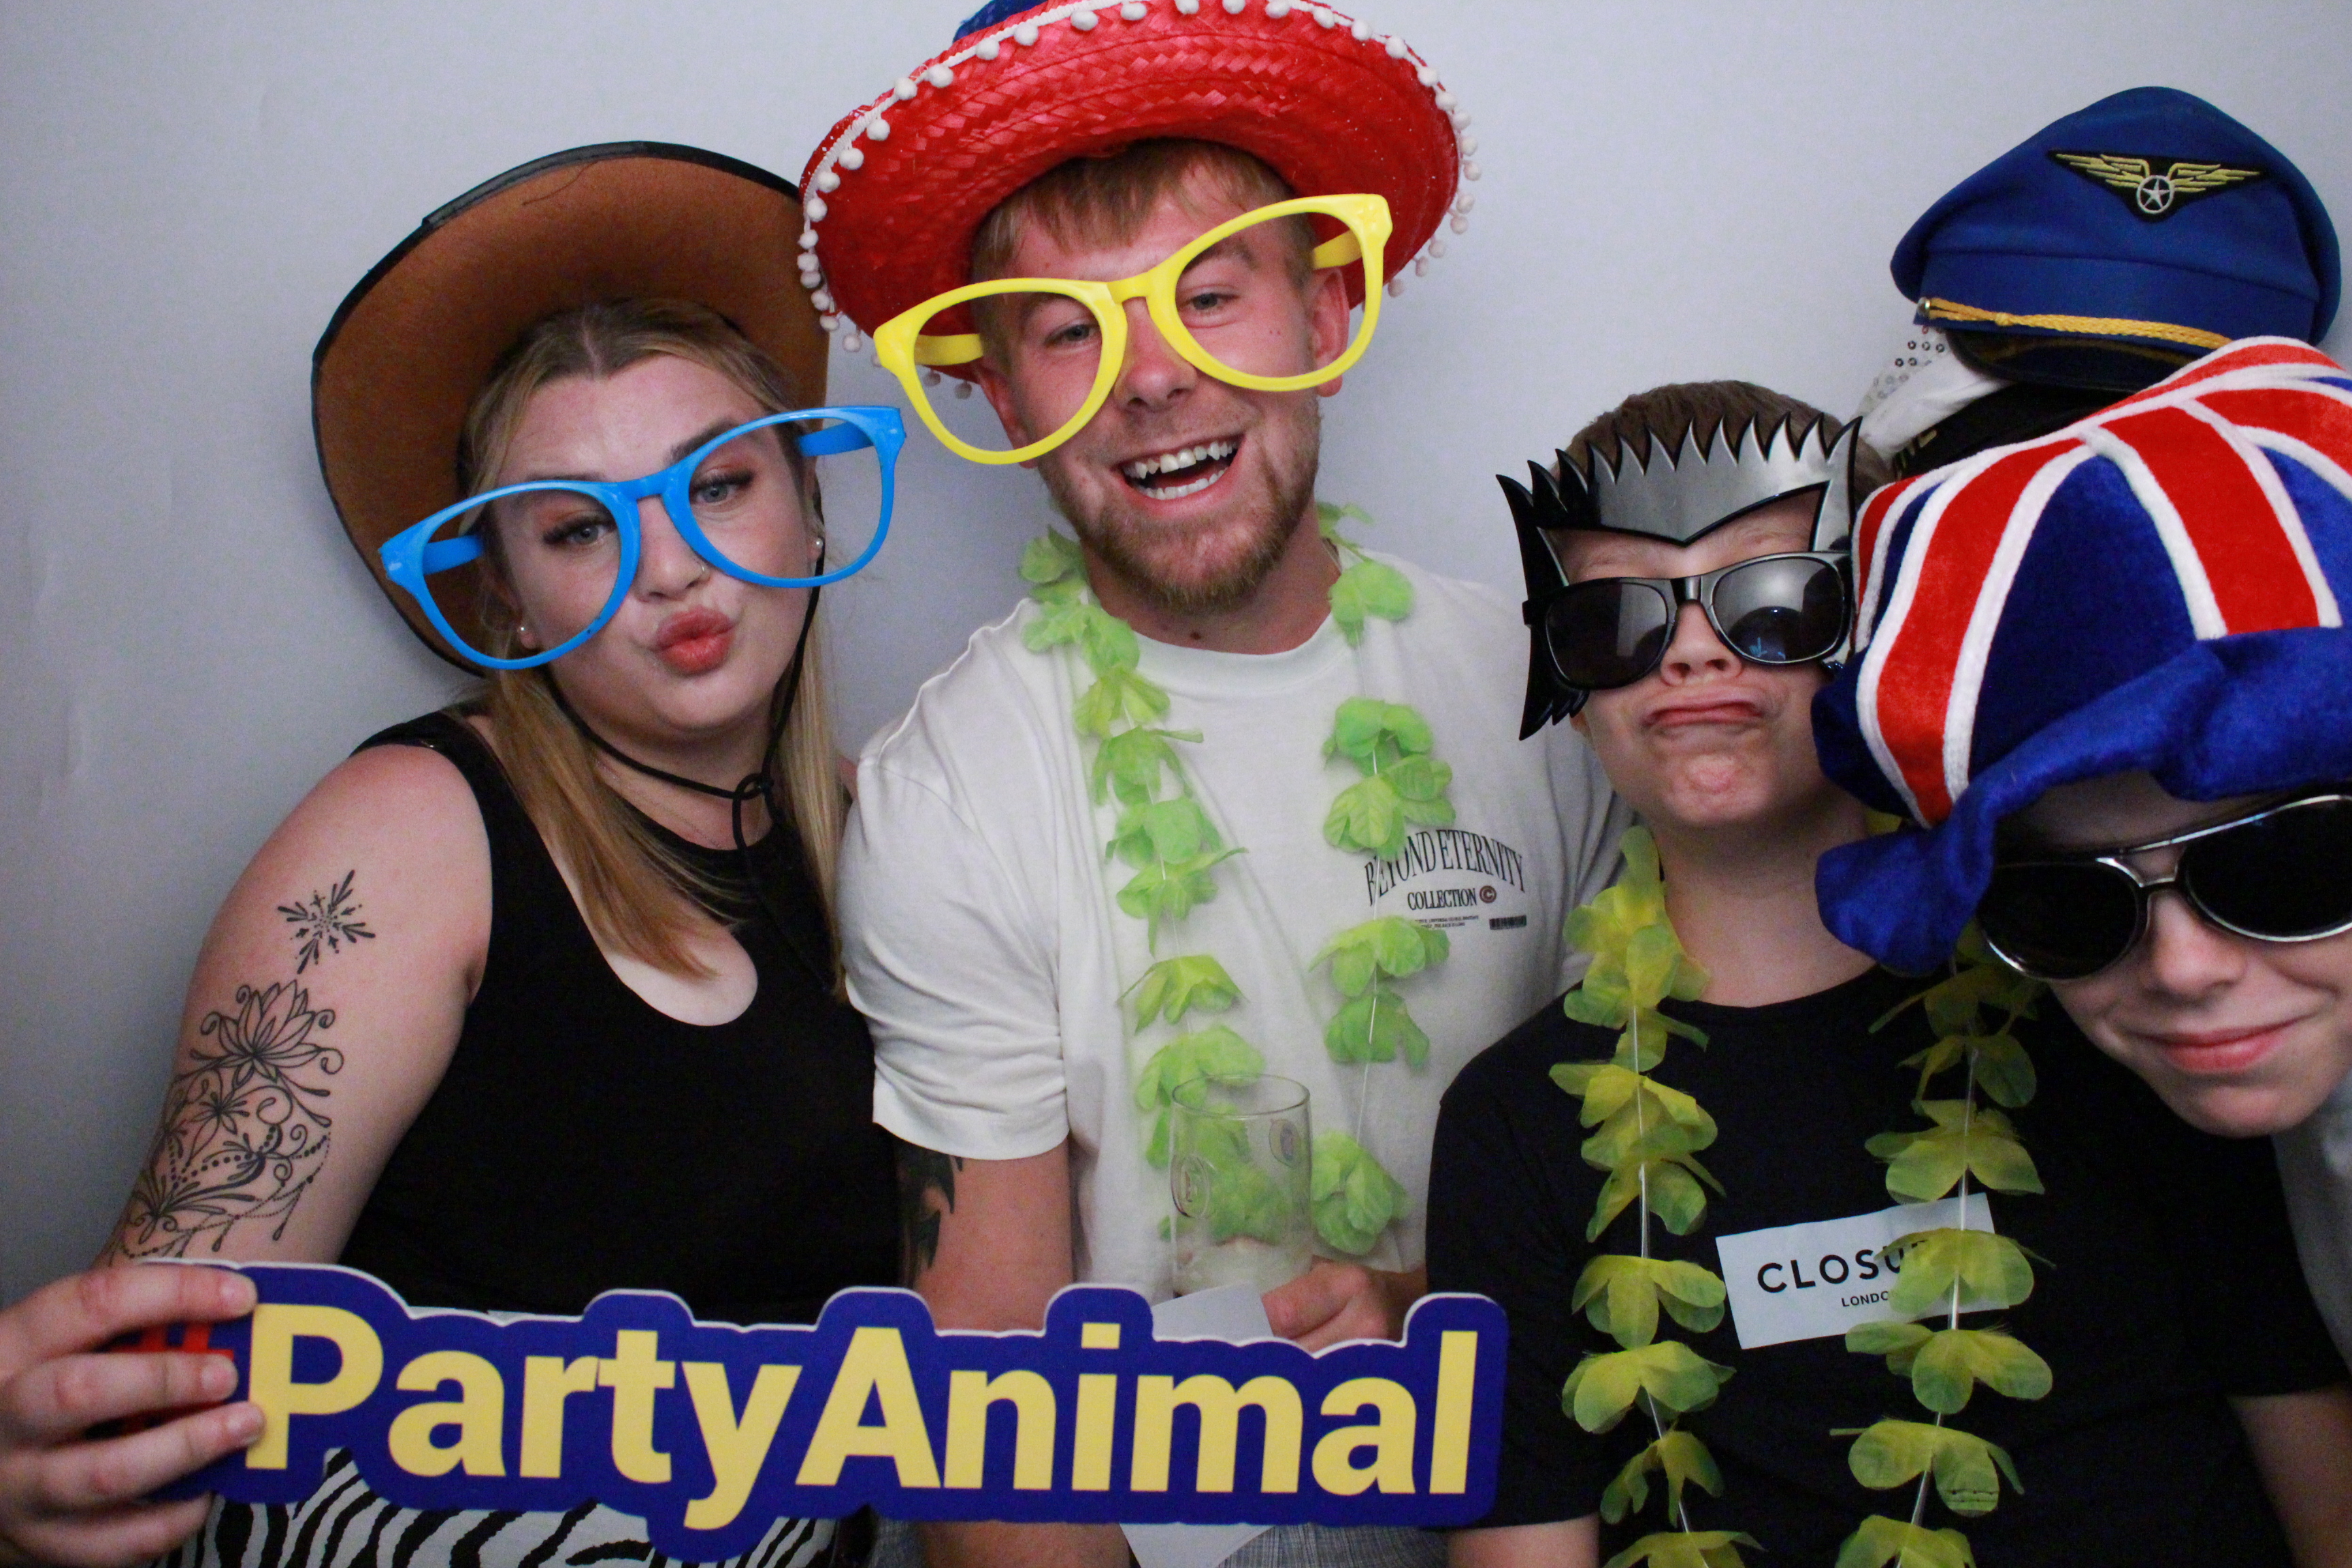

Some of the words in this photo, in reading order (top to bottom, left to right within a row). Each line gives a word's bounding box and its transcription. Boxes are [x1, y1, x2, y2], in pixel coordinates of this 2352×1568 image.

[1435, 829, 1525, 894] ETERNITY
[1407, 887, 1477, 911] COLLECTION
[1757, 1239, 1926, 1293] CLOSU
[1841, 1290, 1889, 1307] LONDO
